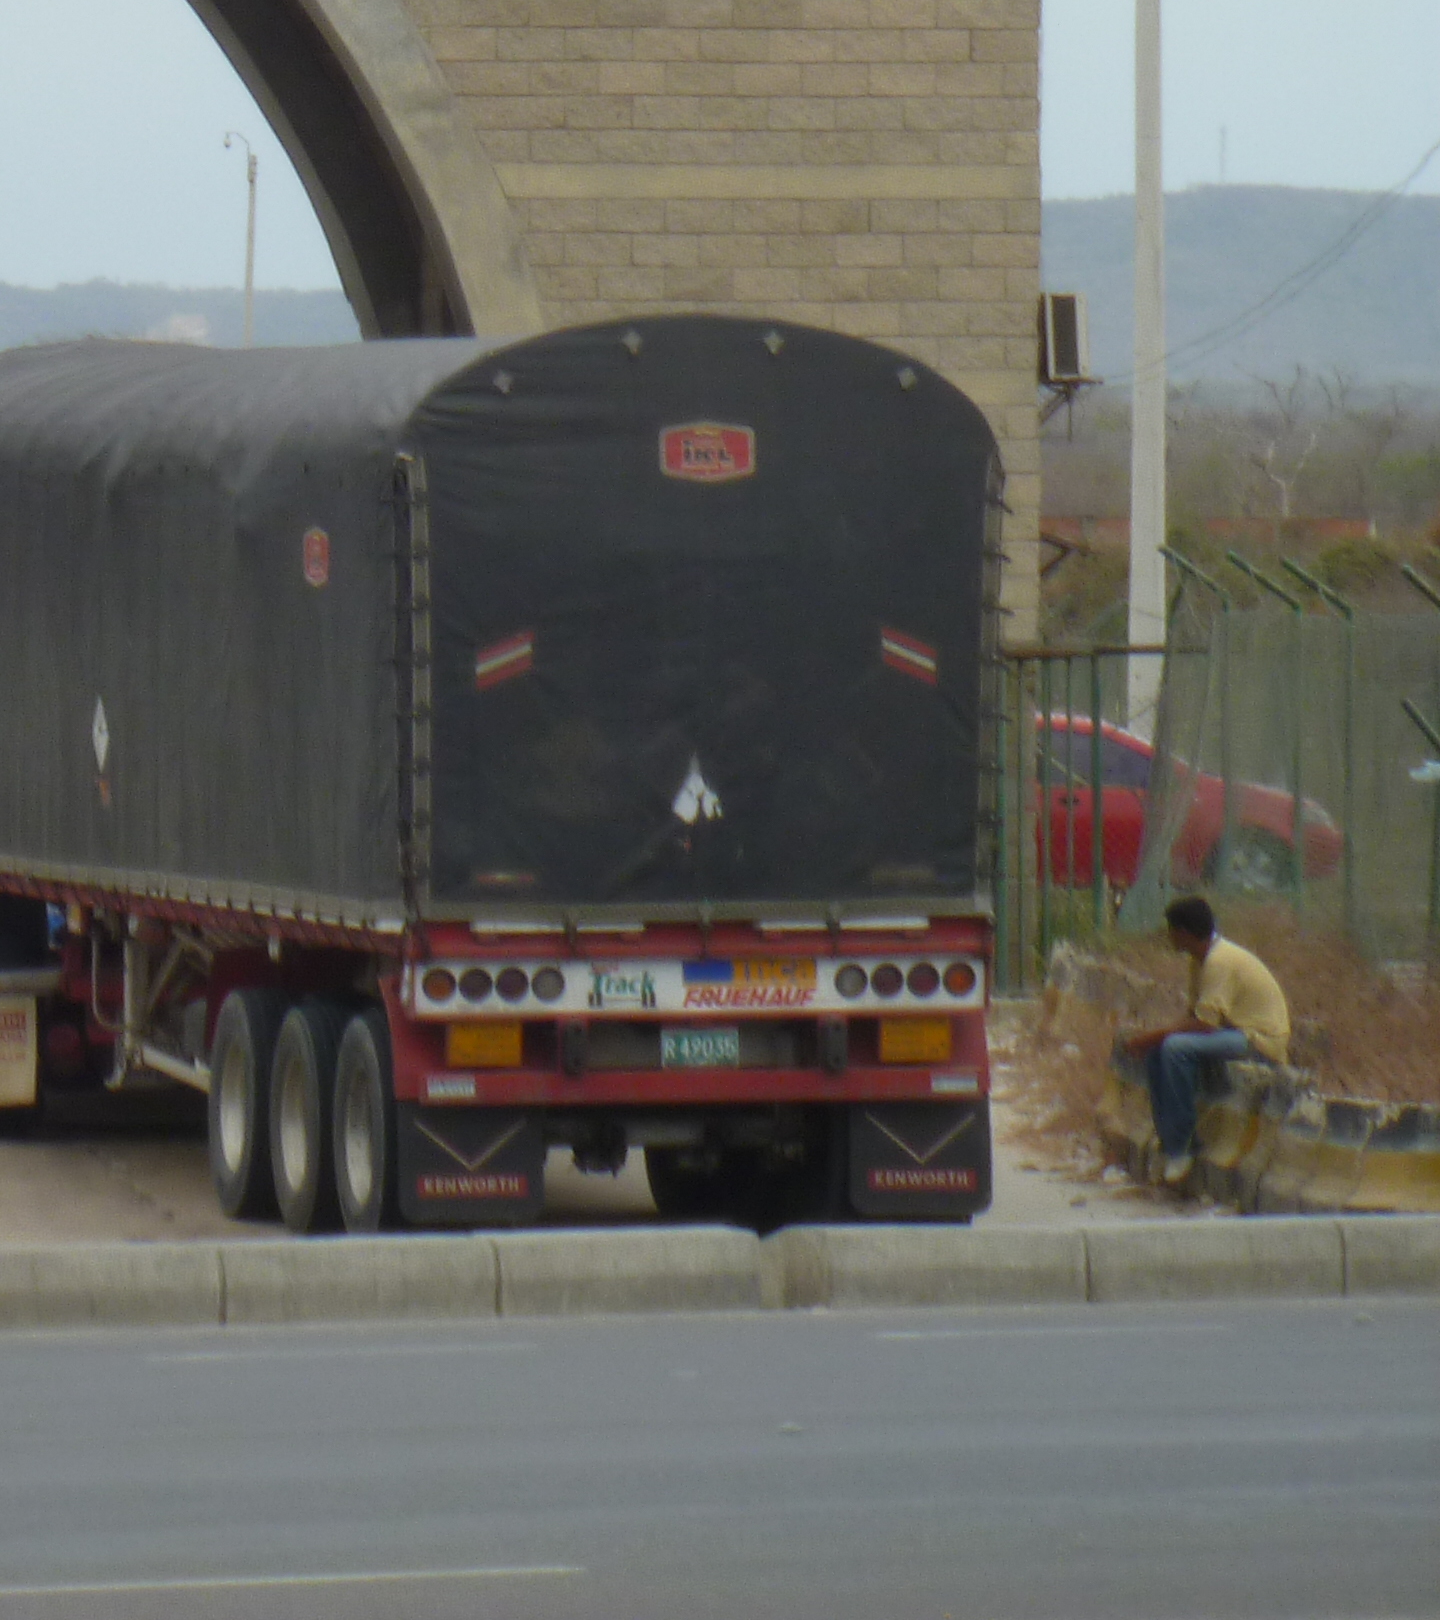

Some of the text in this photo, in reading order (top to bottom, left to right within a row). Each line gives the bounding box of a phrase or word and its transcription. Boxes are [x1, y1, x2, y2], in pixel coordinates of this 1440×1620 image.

[683, 985, 818, 1009] FRUEHAUF
[423, 1176, 520, 1194] KENWORTH
[875, 1168, 969, 1186] KENWORTH
